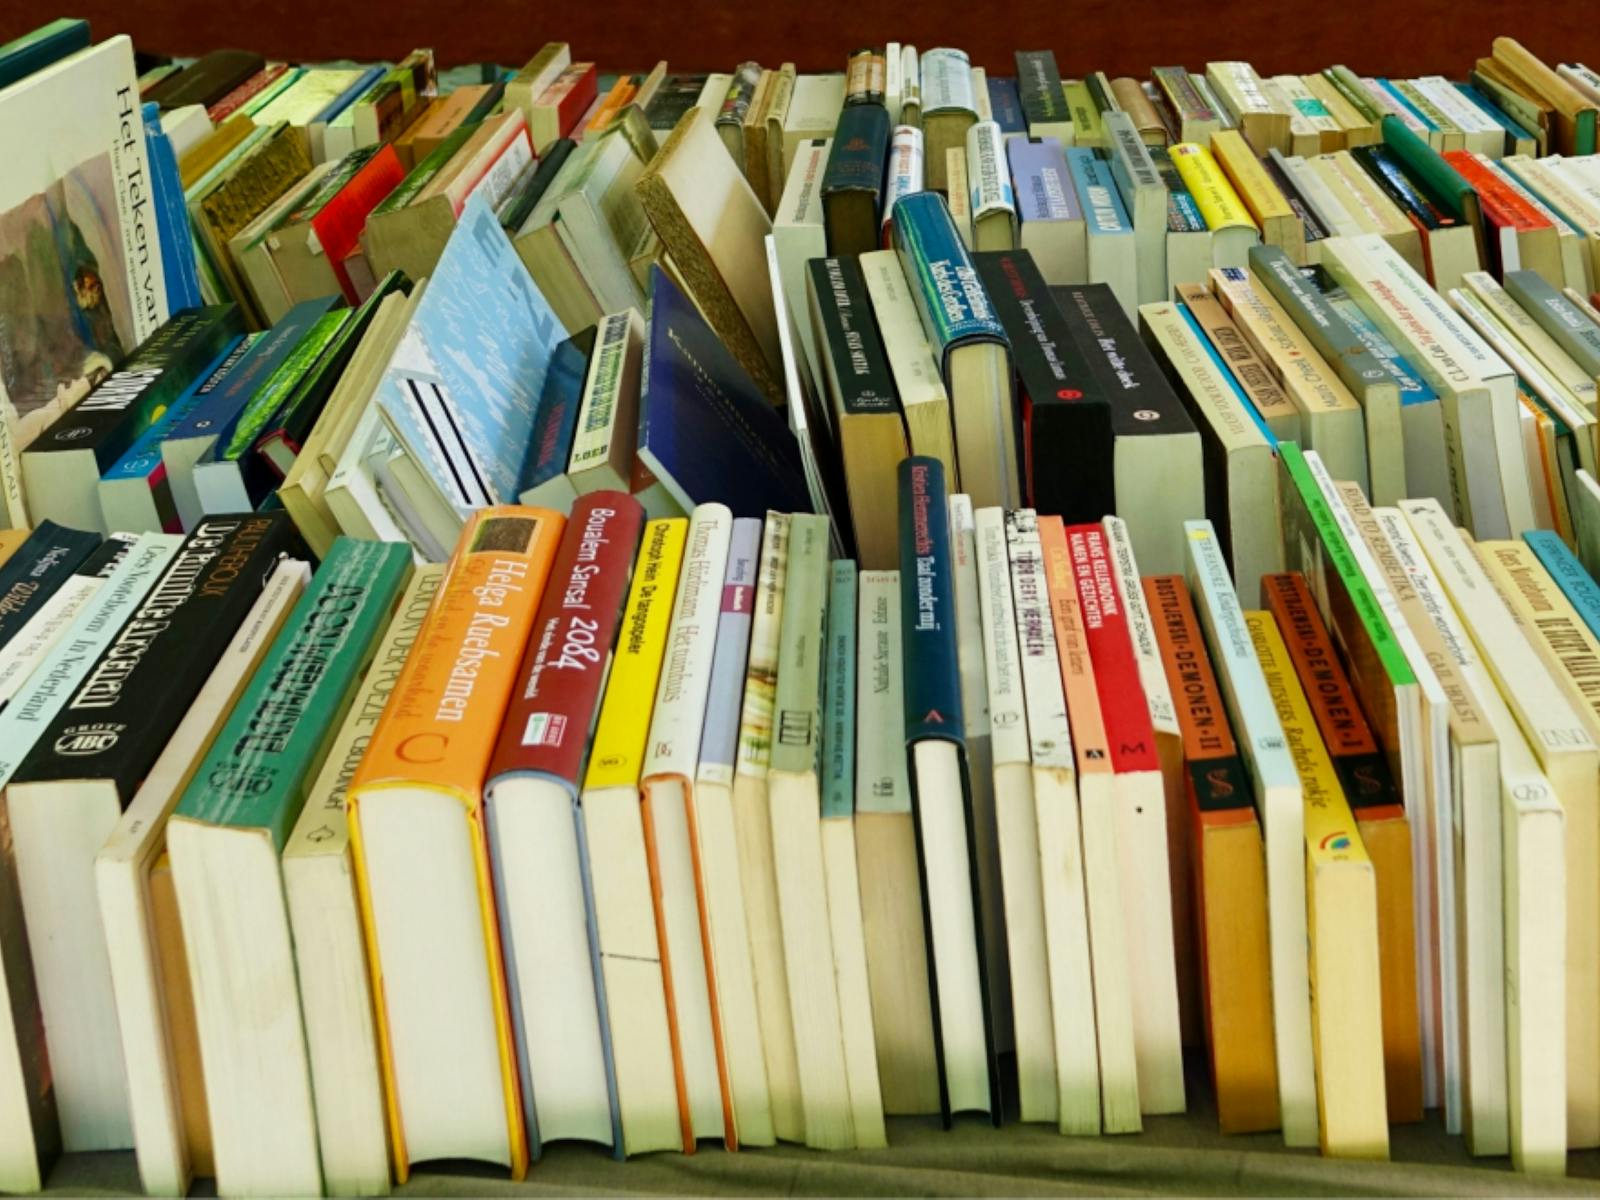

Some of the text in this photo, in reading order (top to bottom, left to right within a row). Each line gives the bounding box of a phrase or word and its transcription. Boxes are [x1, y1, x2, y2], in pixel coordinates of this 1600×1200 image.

[117, 85, 136, 152] Het
[128, 156, 150, 267] Teken
[145, 545, 167, 567] Cees
[188, 520, 239, 550] De
[691, 520, 719, 558] Thomas
[136, 547, 221, 621] familie
[546, 507, 615, 674] Boualem Sansal 2084
[626, 522, 672, 653] Christoph Hein De tangospeler
[70, 619, 170, 710] Arsenal
[434, 557, 530, 724] Helga Ruebsamen
[16, 653, 86, 721] Nederland
[1174, 650, 1215, 729] DEMONEN
[1303, 647, 1353, 731] DEMONEN
